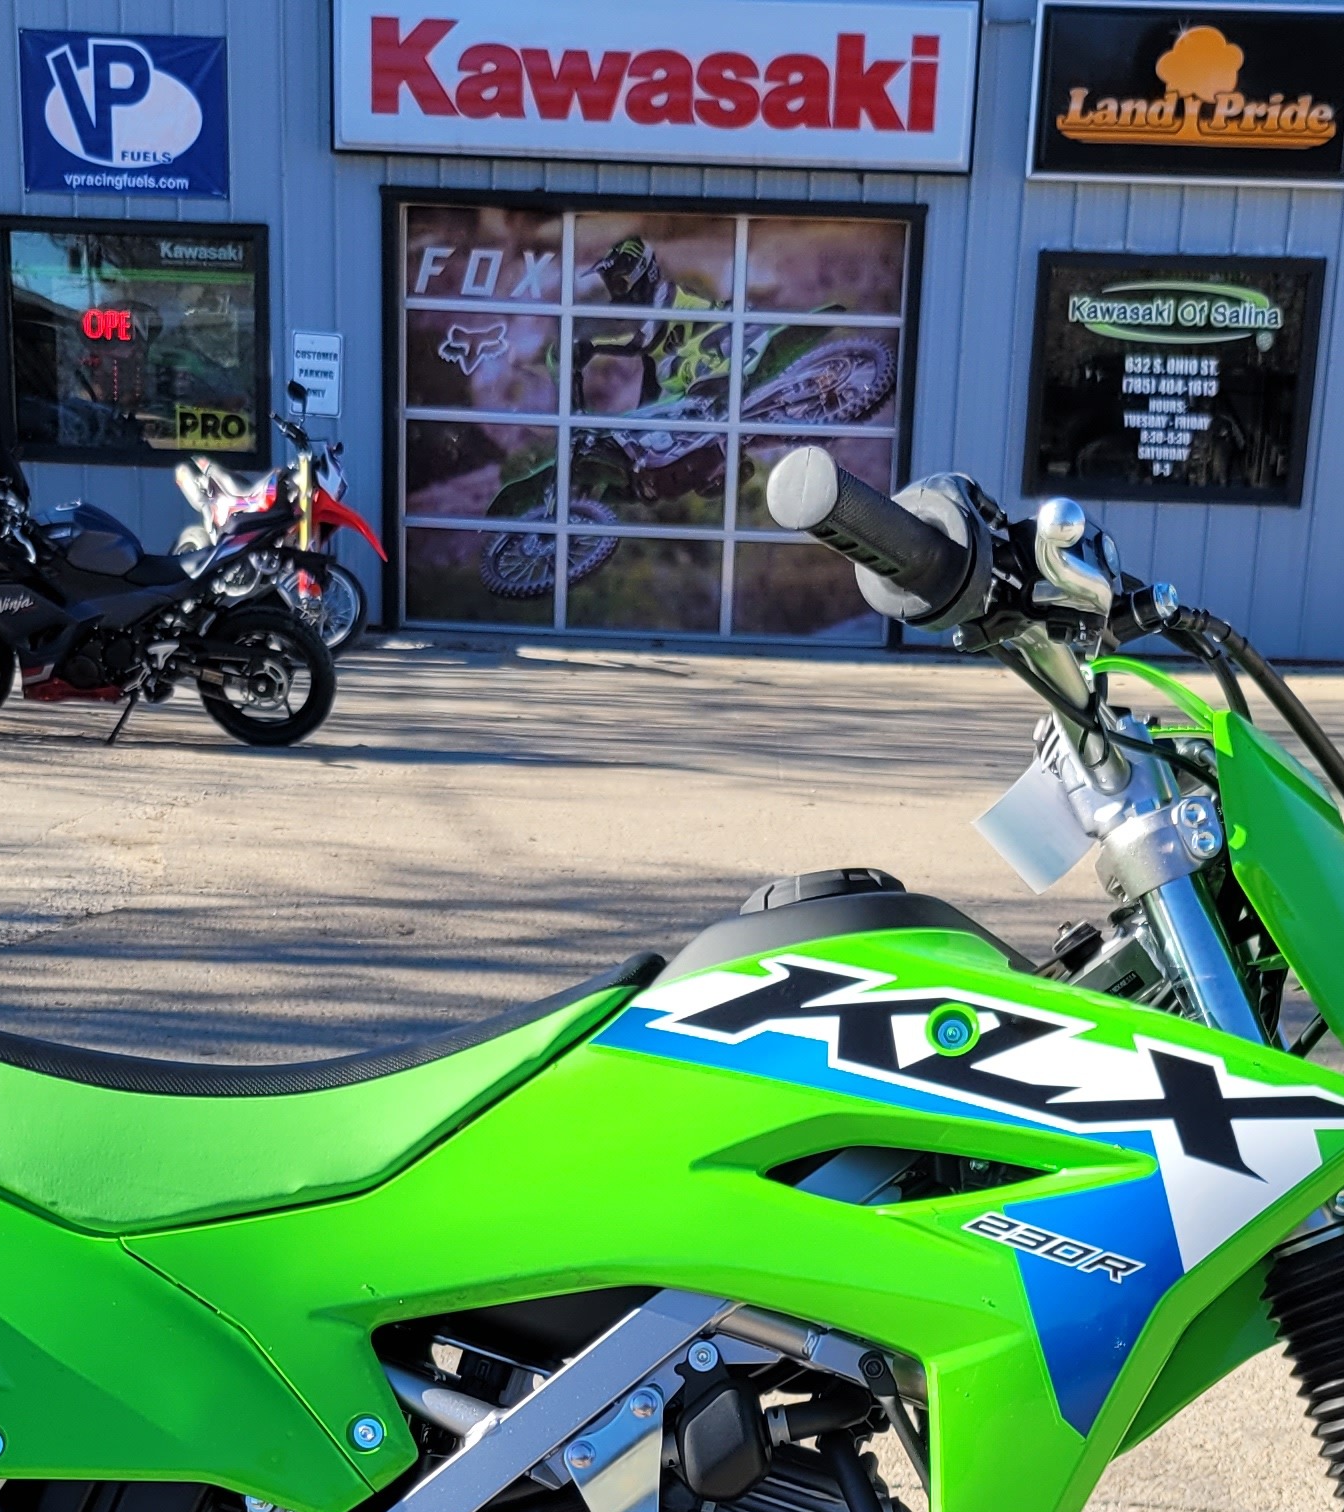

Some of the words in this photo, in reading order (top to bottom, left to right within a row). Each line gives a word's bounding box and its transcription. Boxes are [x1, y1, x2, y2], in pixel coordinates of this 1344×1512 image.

[370, 16, 940, 133] Kawasaki
[46, 38, 154, 165] VP
[1060, 86, 1179, 128] Land
[1208, 91, 1335, 133] Pride
[120, 150, 174, 164] FUELS
[64, 171, 189, 191] vpracingfuels.com
[159, 241, 244, 261] Kawasaki
[414, 246, 556, 299] FOX
[1068, 294, 1174, 327] Kawasaki
[1177, 300, 1208, 327] Of
[1210, 302, 1284, 329] Salina
[295, 349, 339, 362] CUSTOMER
[298, 368, 334, 380] PARKING
[1167, 357, 1198, 376] OHIO
[179, 412, 247, 439] PRO
[1123, 412, 1168, 428] TUESDAY
[1174, 414, 1212, 431] FRIDAY
[1137, 446, 1191, 462] SATURDAY
[962, 1211, 1147, 1284] 230R
